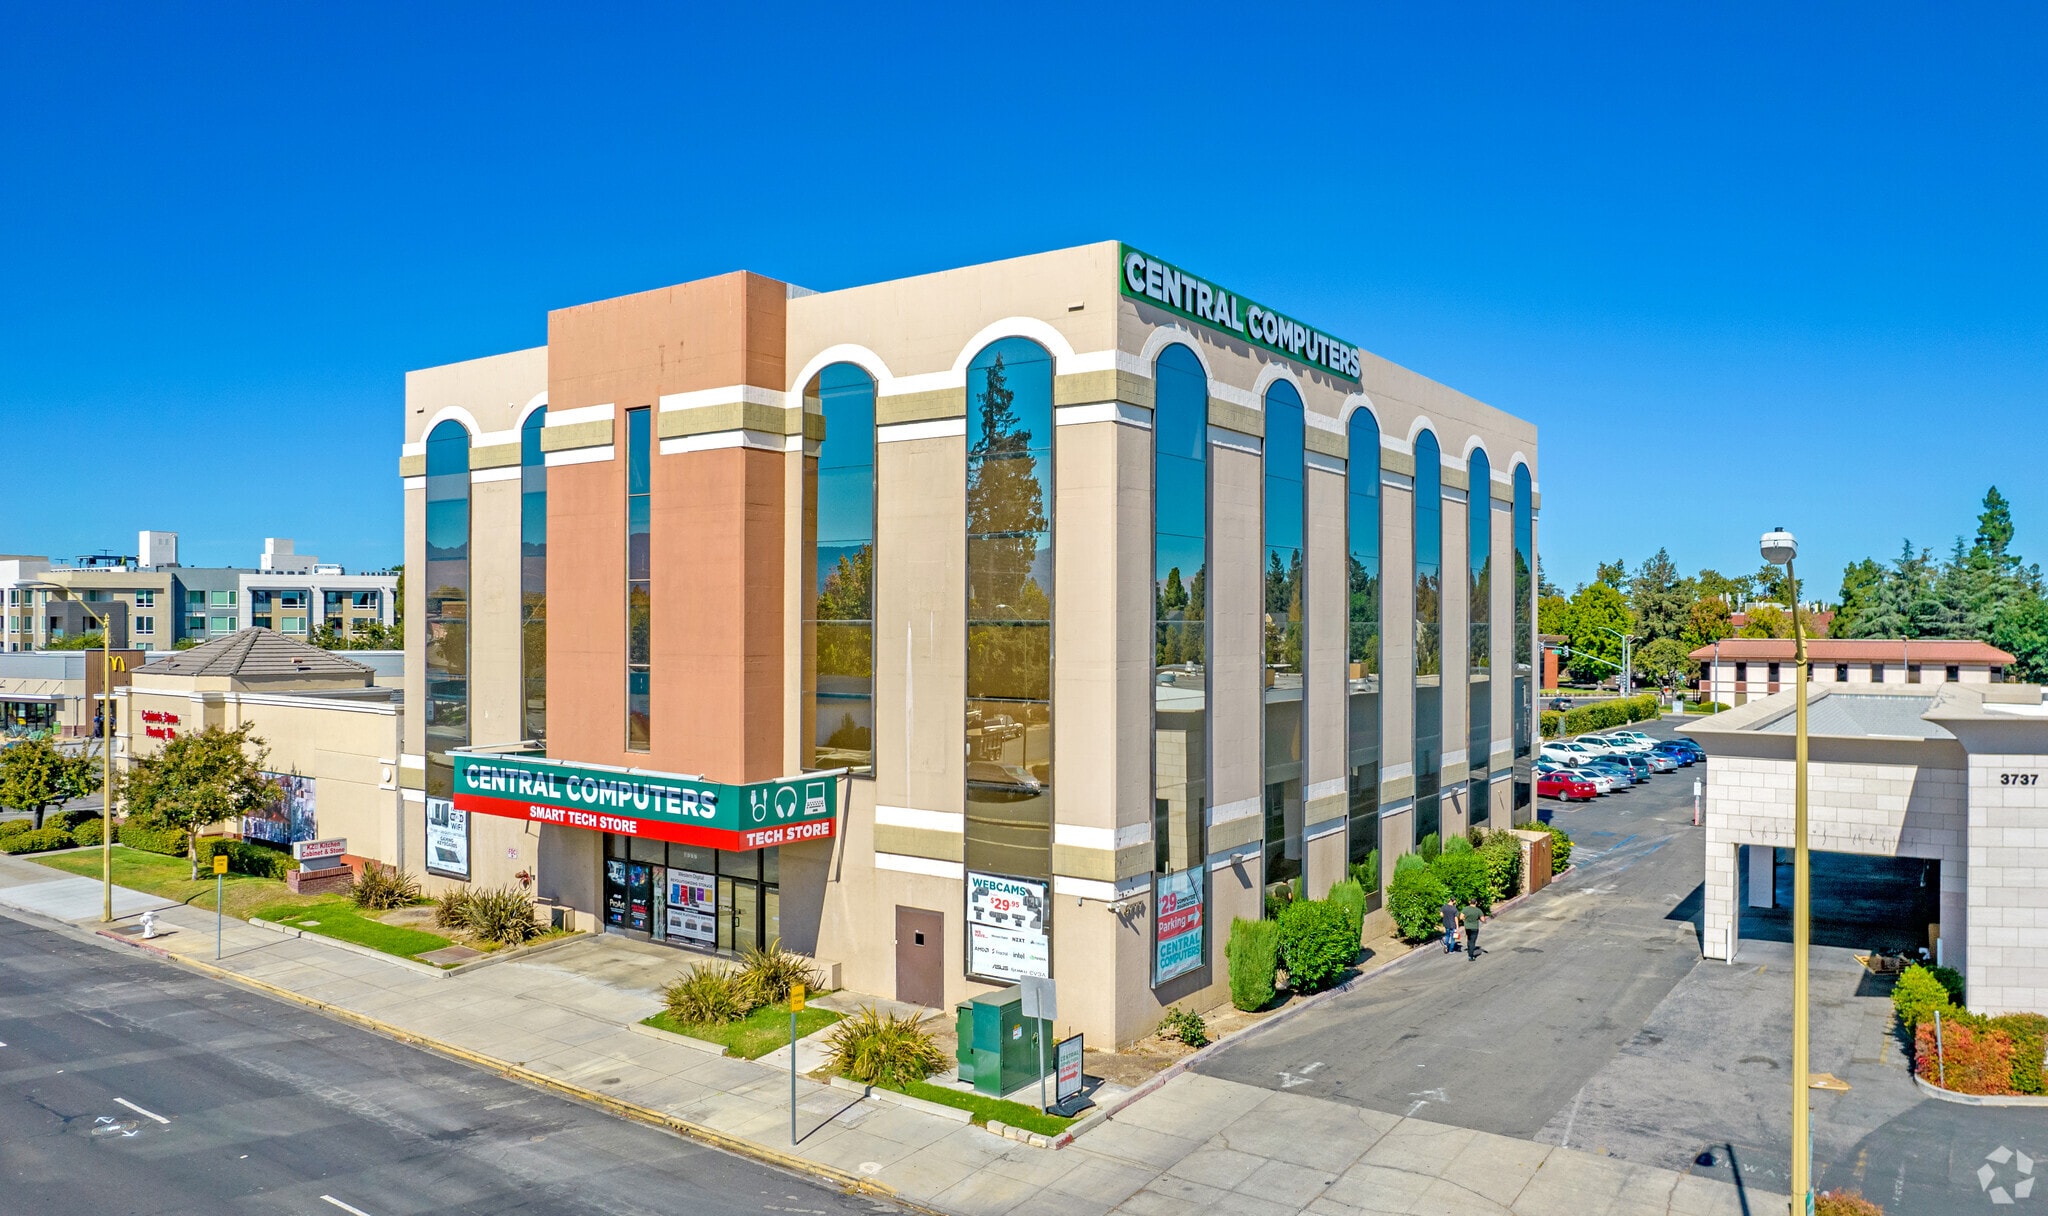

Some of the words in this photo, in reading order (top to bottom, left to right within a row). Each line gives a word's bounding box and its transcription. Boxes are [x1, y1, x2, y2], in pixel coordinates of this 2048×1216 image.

[1123, 252, 1244, 333] CENTRAL
[1246, 304, 1361, 378] COMPUTERS
[2001, 773, 2039, 786] 3737
[466, 763, 561, 799] CENTRAL
[566, 775, 716, 819] COMPUTERS
[529, 805, 564, 821] SMART
[567, 813, 597, 828] TECH
[599, 817, 637, 834] STORE
[746, 828, 783, 847] TECH
[786, 821, 830, 841] STORE
[301, 850, 323, 858] Cabinet
[320, 841, 341, 849] Kitchen
[972, 877, 1026, 896] WEBCAMS
[1158, 916, 1187, 934] Parking
[1160, 932, 1201, 957] CENTRAL
[1012, 952, 1026, 960] intel
[1160, 945, 1201, 969] COMPUTERS
